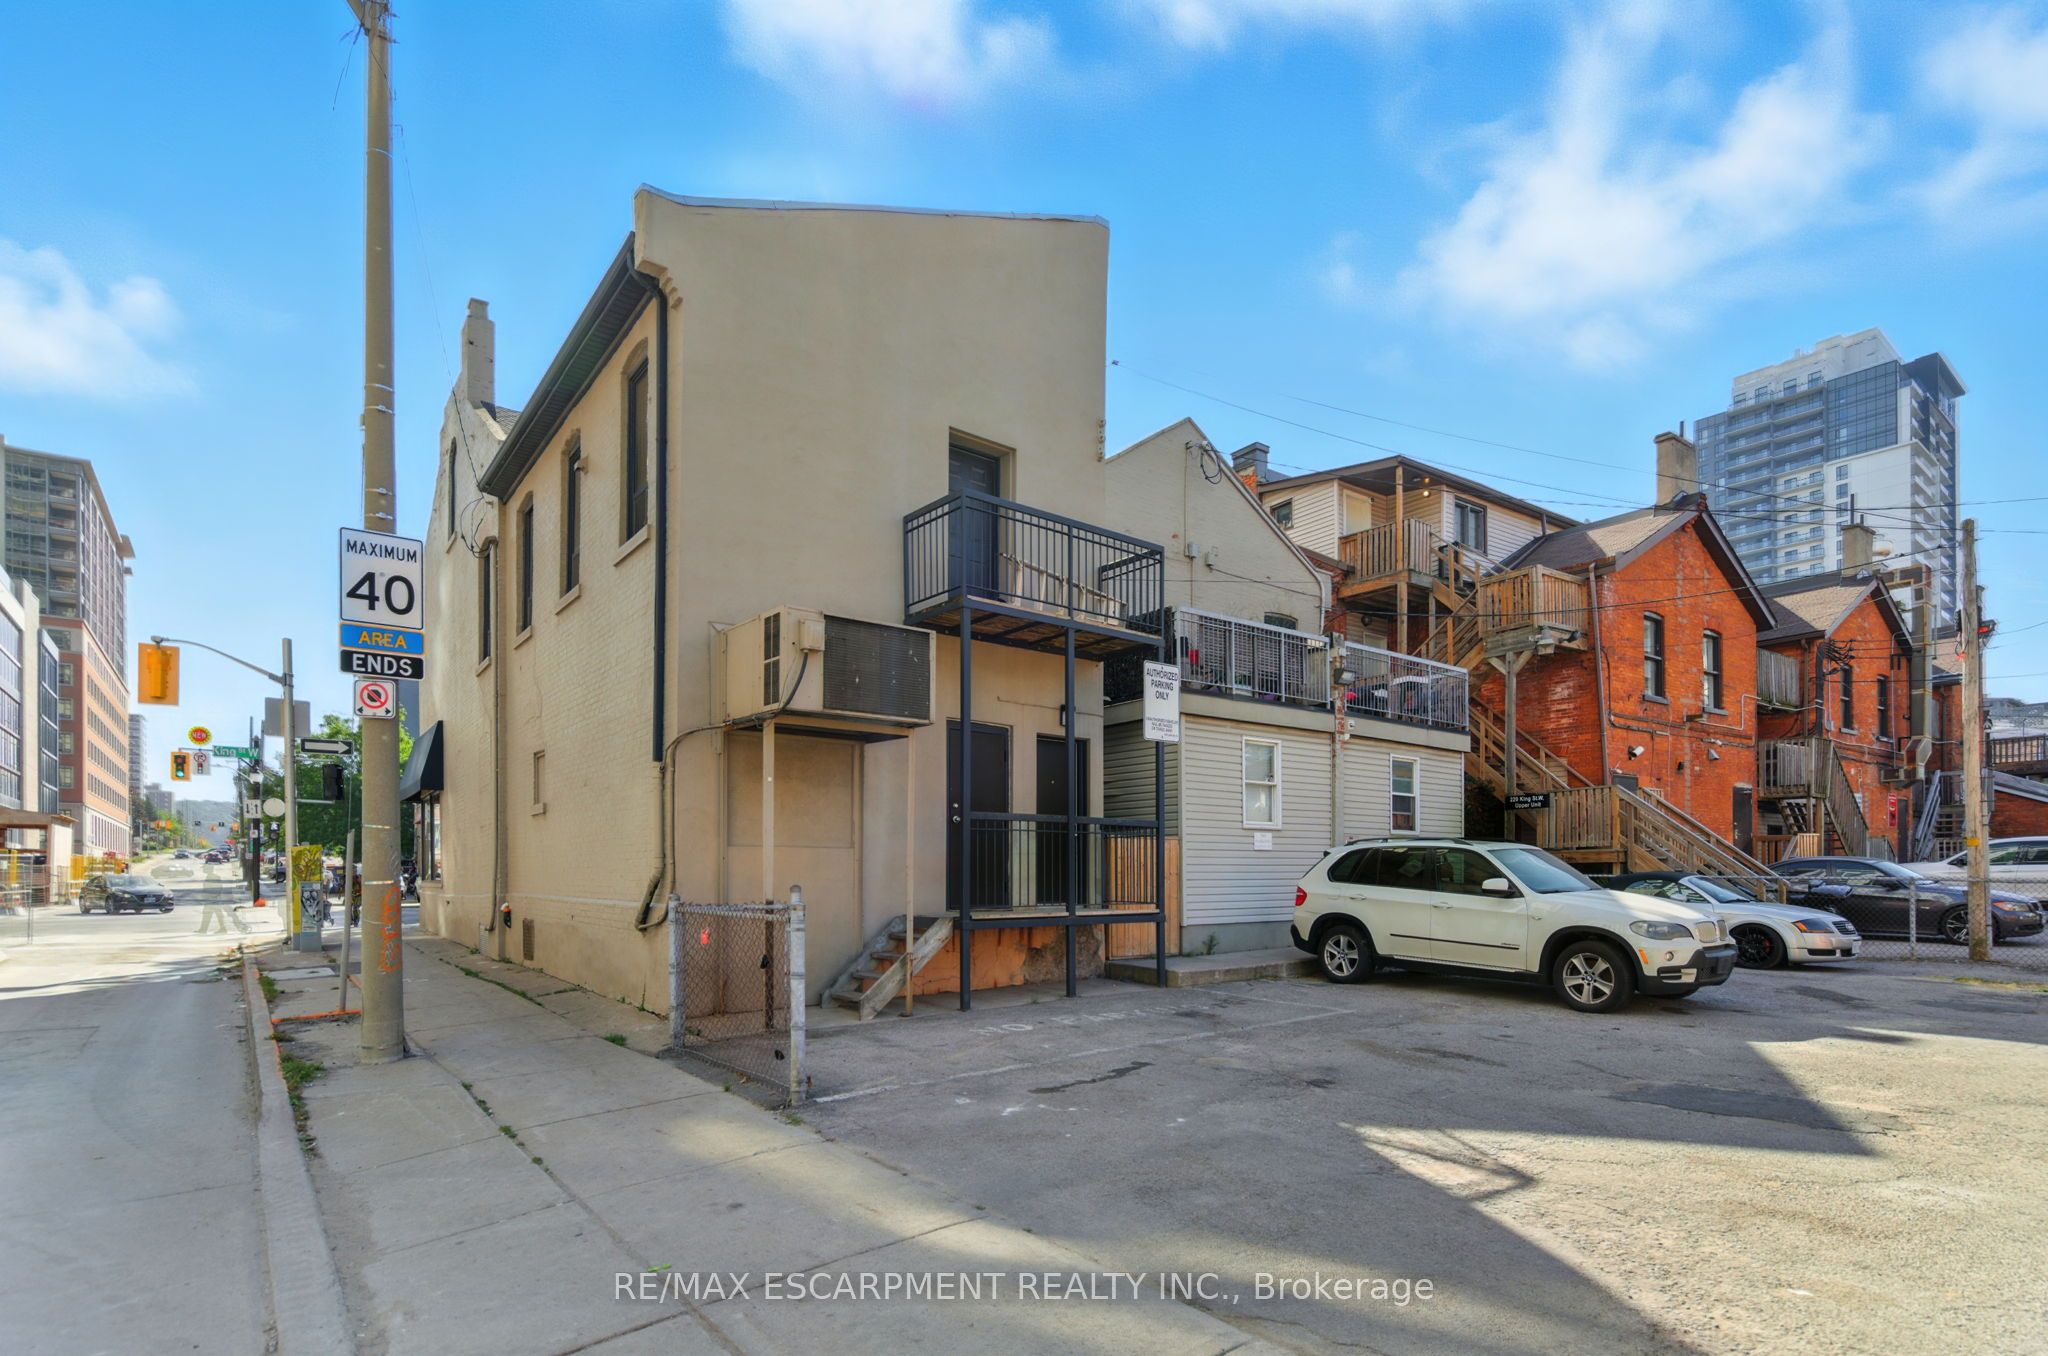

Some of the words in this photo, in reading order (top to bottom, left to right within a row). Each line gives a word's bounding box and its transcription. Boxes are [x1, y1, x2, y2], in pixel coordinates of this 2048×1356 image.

[346, 539, 417, 563] MAXIMUM
[346, 571, 415, 615] 40
[358, 631, 407, 649] AREA
[352, 653, 413, 676] ENDS
[1146, 668, 1178, 681] AUTHORIZED
[1151, 679, 1174, 691] PARKING
[1155, 690, 1170, 701] ONLY
[213, 745, 236, 757] King
[248, 748, 259, 758] W
